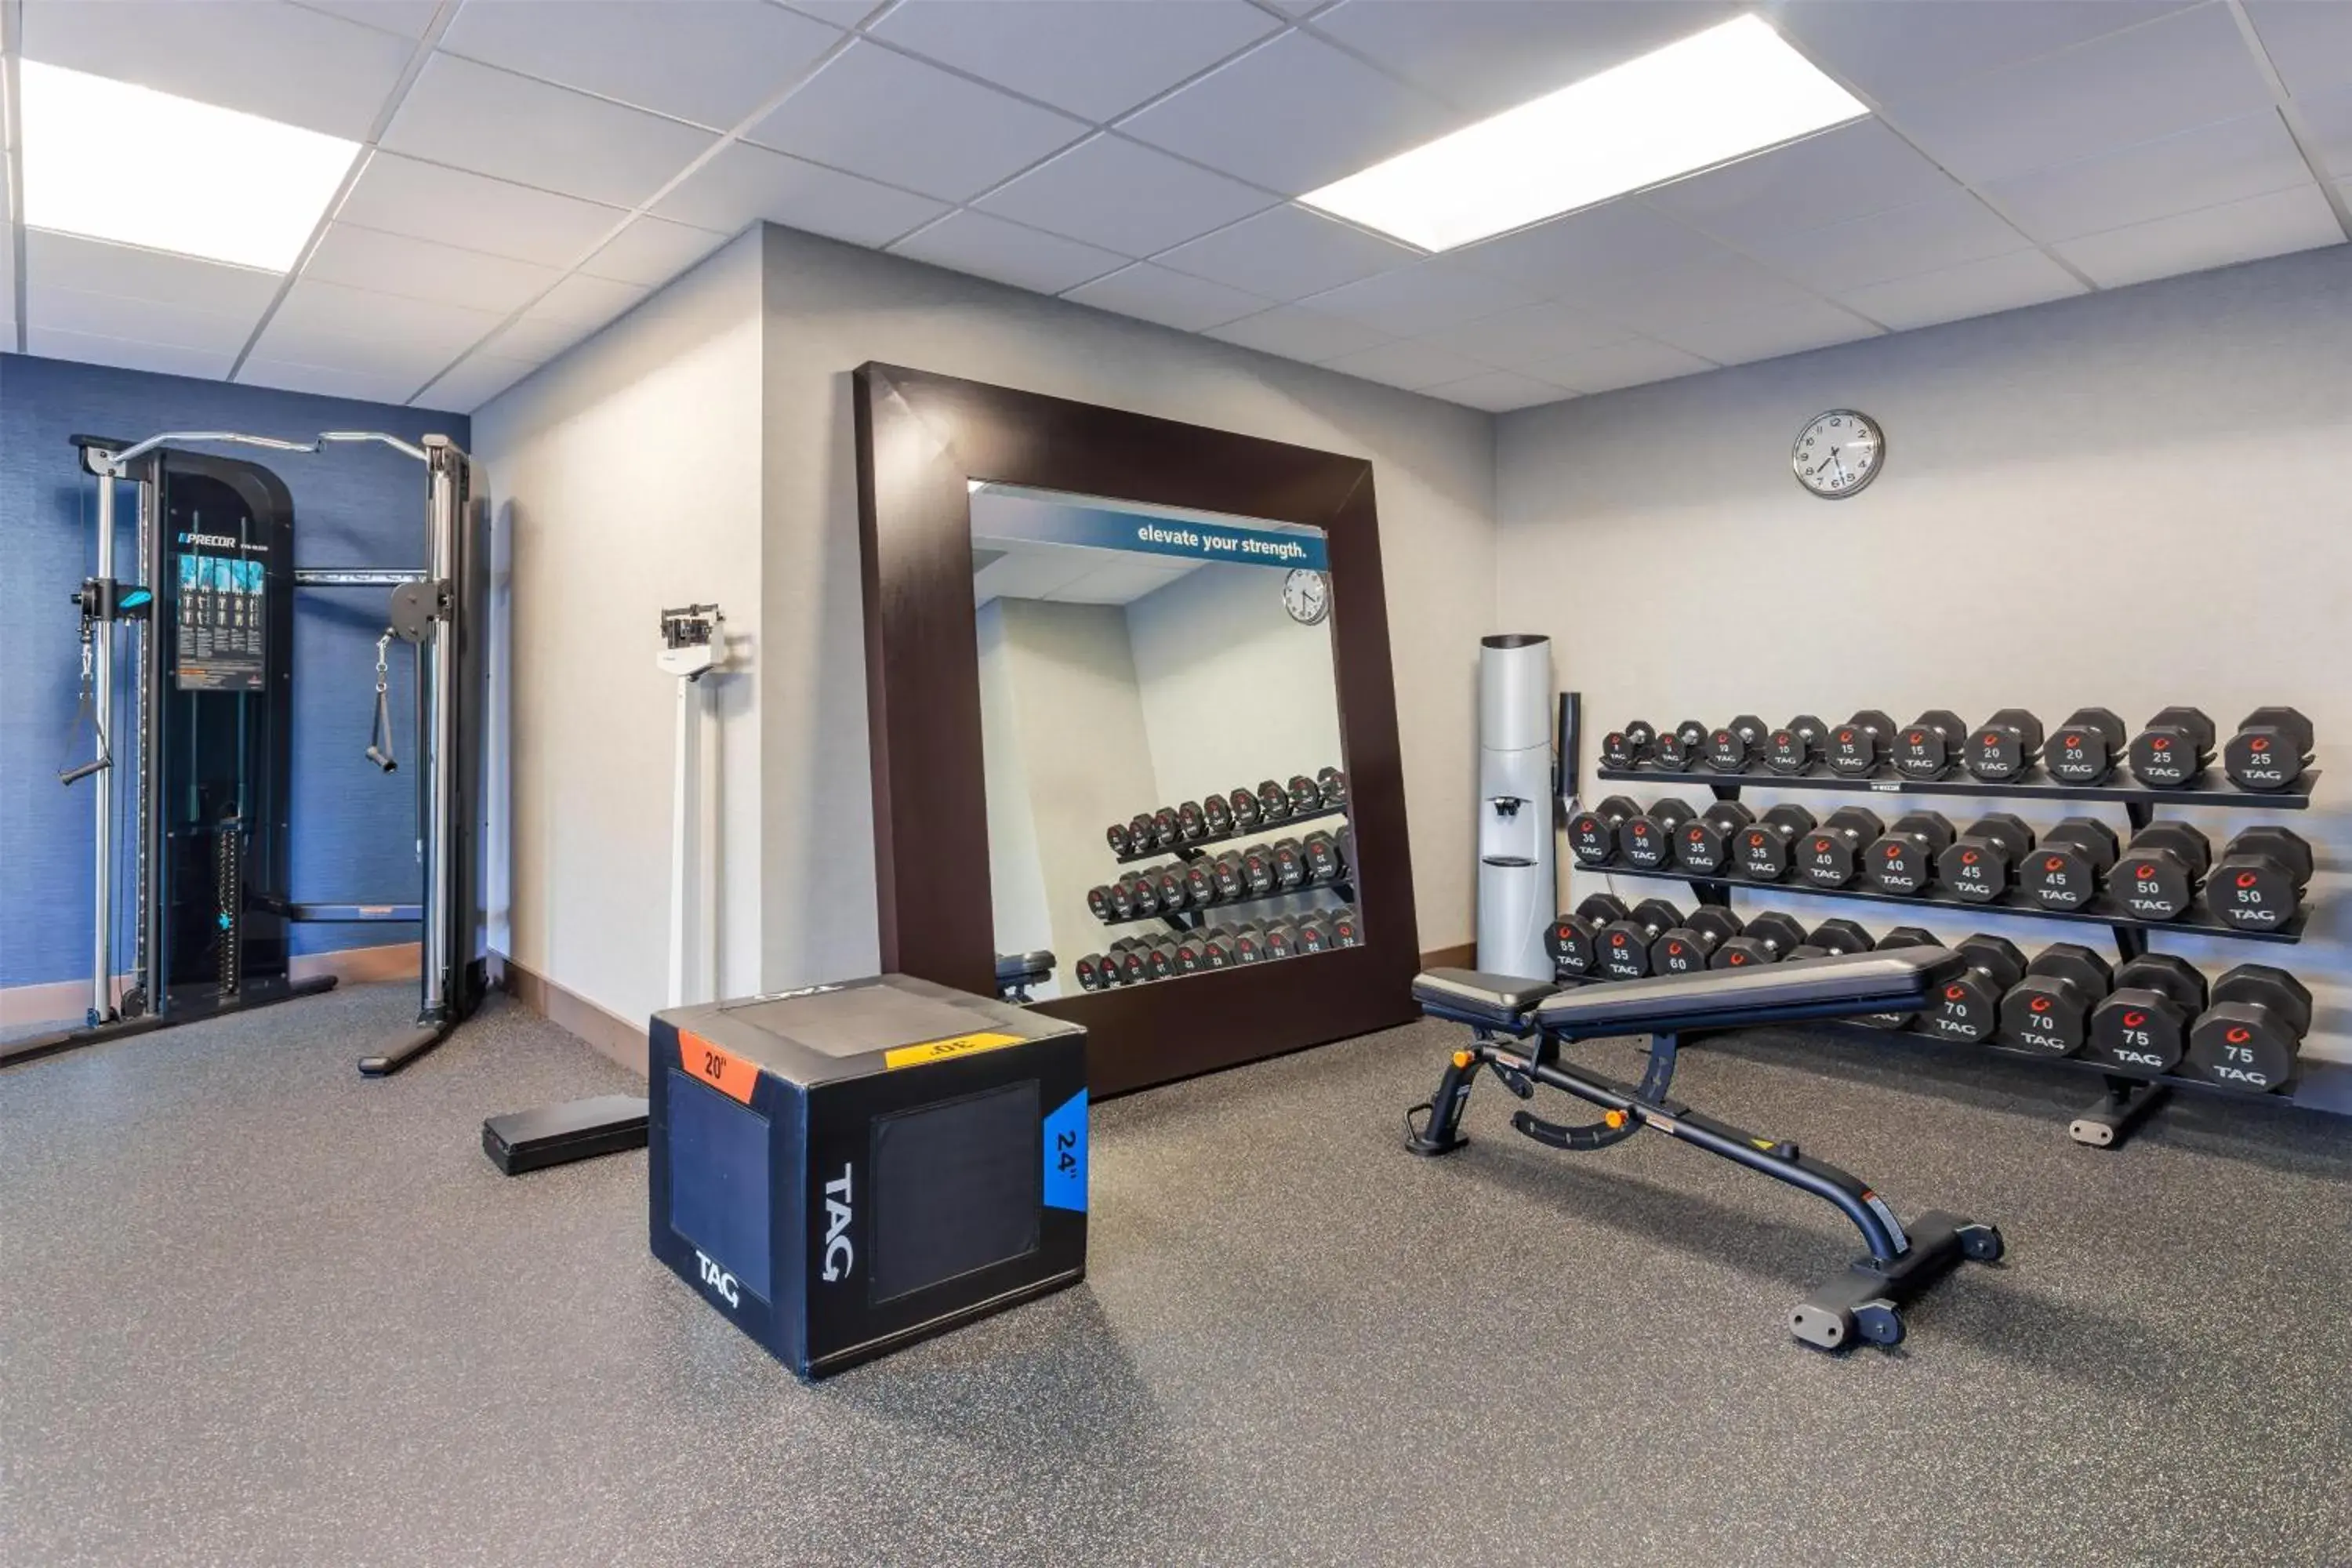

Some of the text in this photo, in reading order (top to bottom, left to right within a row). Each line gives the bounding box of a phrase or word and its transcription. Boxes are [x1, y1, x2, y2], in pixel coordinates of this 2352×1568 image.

[187, 533, 236, 547] PRECOR
[1138, 524, 1308, 559] elevate your strength.
[1842, 744, 1855, 753] 15
[1911, 746, 1925, 756] 15
[1984, 747, 2000, 758] 20
[2066, 749, 2083, 760] 20
[1836, 757, 1864, 766] TAG
[1904, 759, 1933, 768] TAG
[2153, 752, 2171, 763] 25
[2251, 753, 2271, 764] 25
[1979, 761, 2008, 771] TAG
[2145, 767, 2180, 778] TAG
[2242, 769, 2281, 780] TAG
[1583, 833, 1596, 844] 30
[1635, 837, 1649, 848] 30
[1579, 846, 1602, 856] TAG
[1691, 842, 1705, 853] 35
[1751, 848, 1767, 858] 35
[1631, 851, 1657, 860] TAG
[1686, 856, 1713, 866] TAG
[1816, 854, 1832, 865] 40
[1748, 862, 1776, 872] TAG
[1886, 860, 1904, 871] 40
[1810, 868, 1842, 880] TAG
[1962, 866, 1981, 879] 45
[1881, 874, 1914, 887] TAG
[2045, 873, 2066, 885] 45
[1955, 881, 1990, 895] TAG
[2137, 880, 2159, 894] 50
[2038, 889, 2077, 902] TAG
[2237, 890, 2262, 904] 50
[2129, 899, 2172, 912] TAG
[2229, 909, 2276, 921] TAG
[1560, 940, 1576, 953] 55
[1613, 948, 1629, 960] 55
[1557, 955, 1584, 967] TAG
[1669, 957, 1686, 970] 60
[1610, 964, 1639, 976] TAG
[1944, 1001, 1967, 1017] 70
[1936, 1018, 1977, 1036] TAG
[2029, 1014, 2053, 1029] 70
[2020, 1032, 2065, 1050] TAG
[2122, 1029, 2149, 1046] 75
[2113, 1048, 2163, 1068] TAG
[2224, 1045, 2254, 1063] 75
[706, 1051, 727, 1080] 20"
[2213, 1065, 2267, 1087] TAG
[1058, 1130, 1078, 1179] 24"
[822, 1162, 854, 1282] TAG
[695, 1249, 739, 1309] TAG
